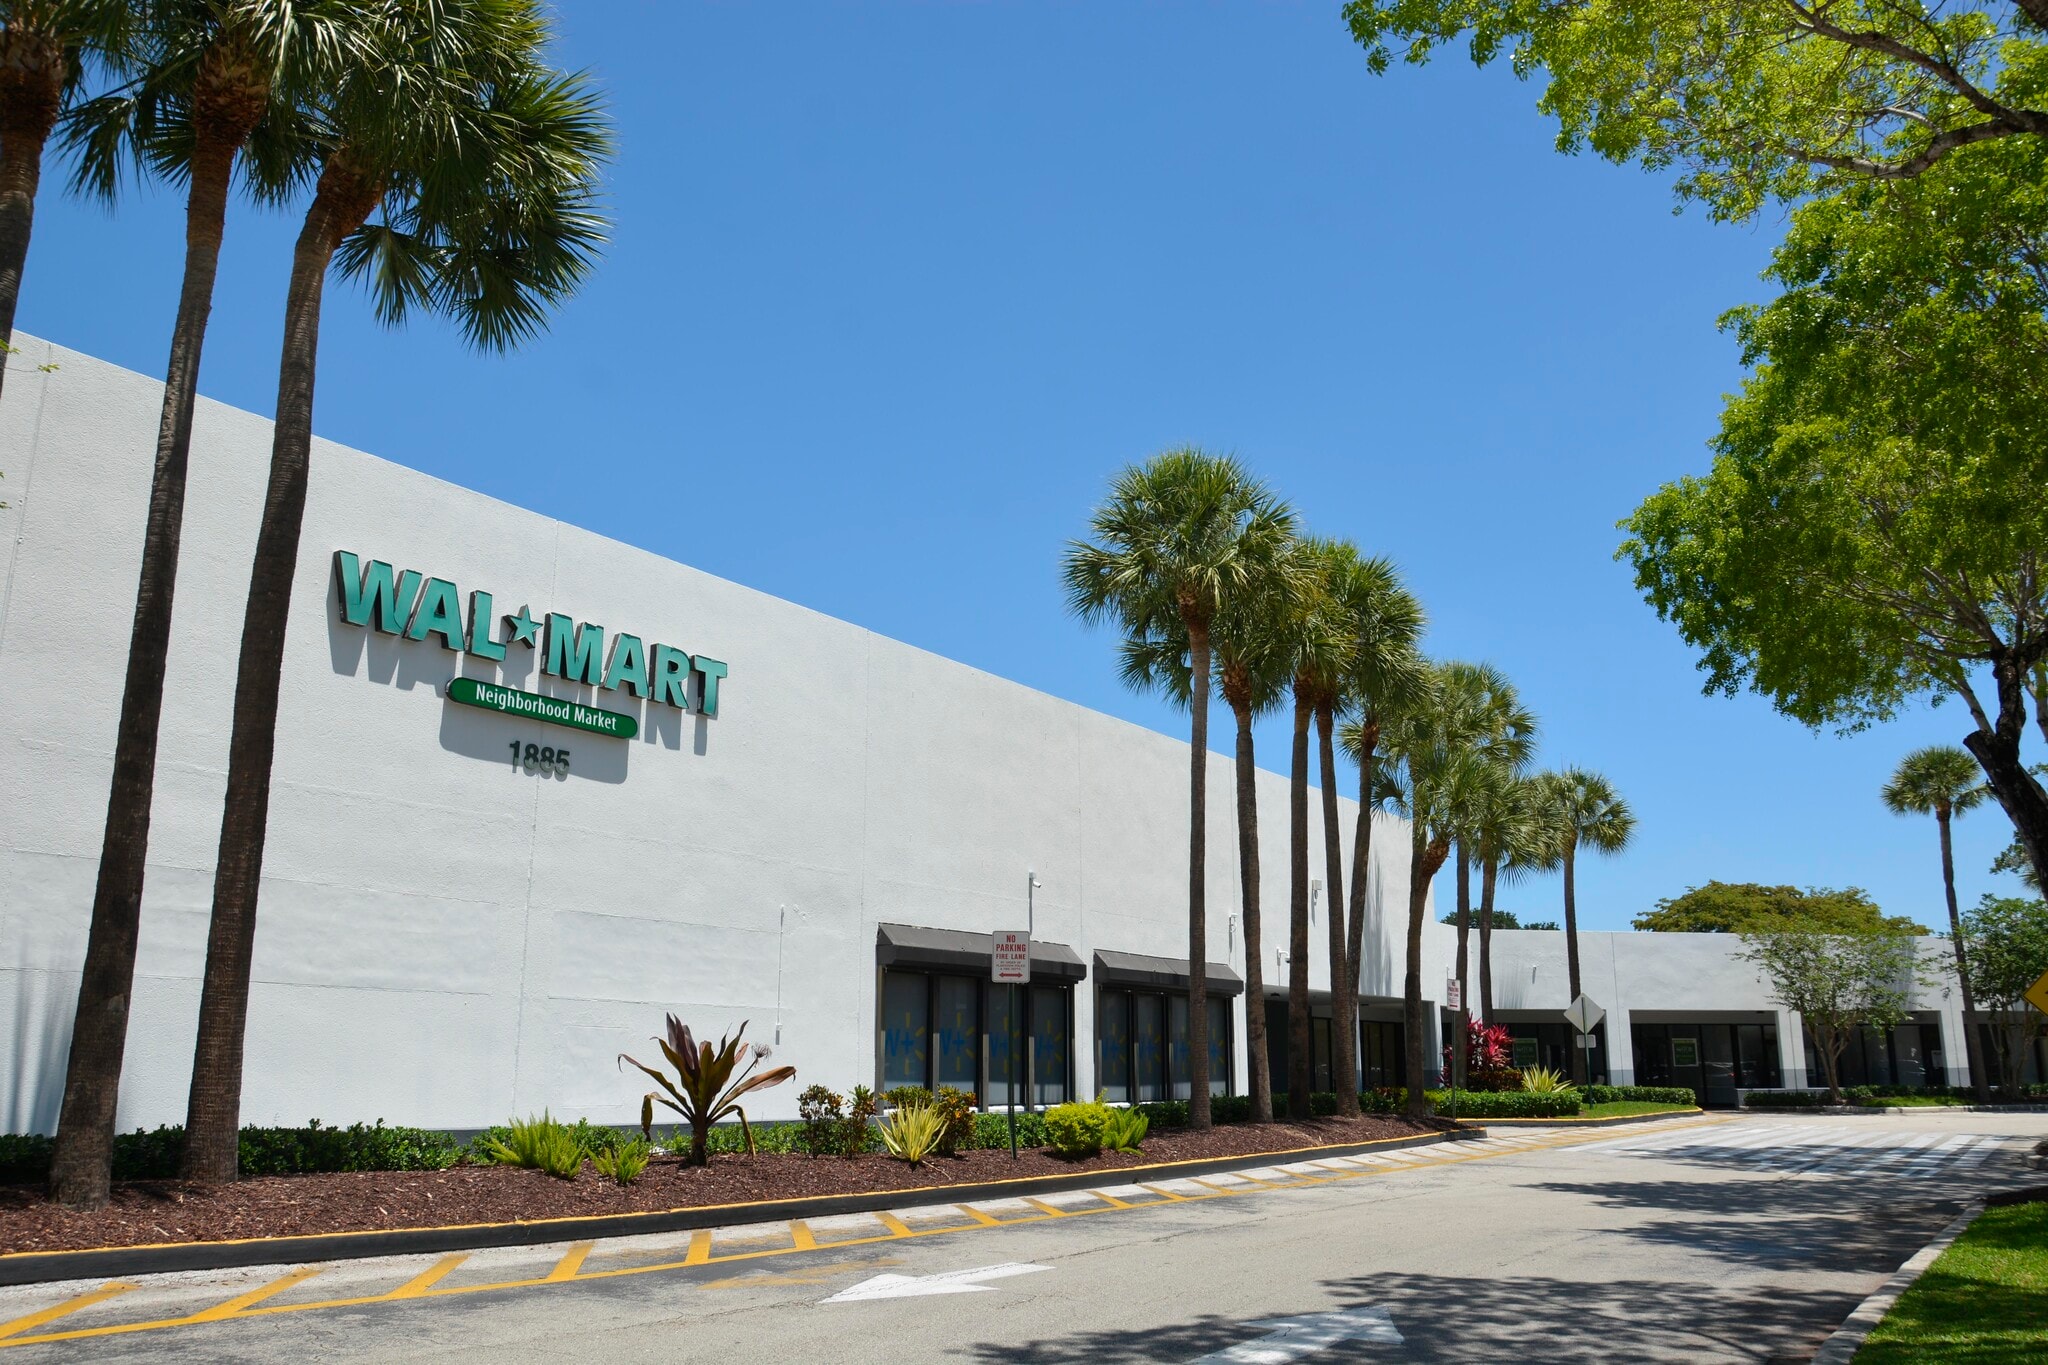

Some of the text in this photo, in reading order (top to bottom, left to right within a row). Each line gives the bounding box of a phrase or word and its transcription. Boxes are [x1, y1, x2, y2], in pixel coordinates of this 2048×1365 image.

[476, 683, 617, 731] Neighborhood Market
[509, 740, 571, 777] 1885
[996, 944, 1026, 952] PARKING
[1006, 935, 1016, 943] NO
